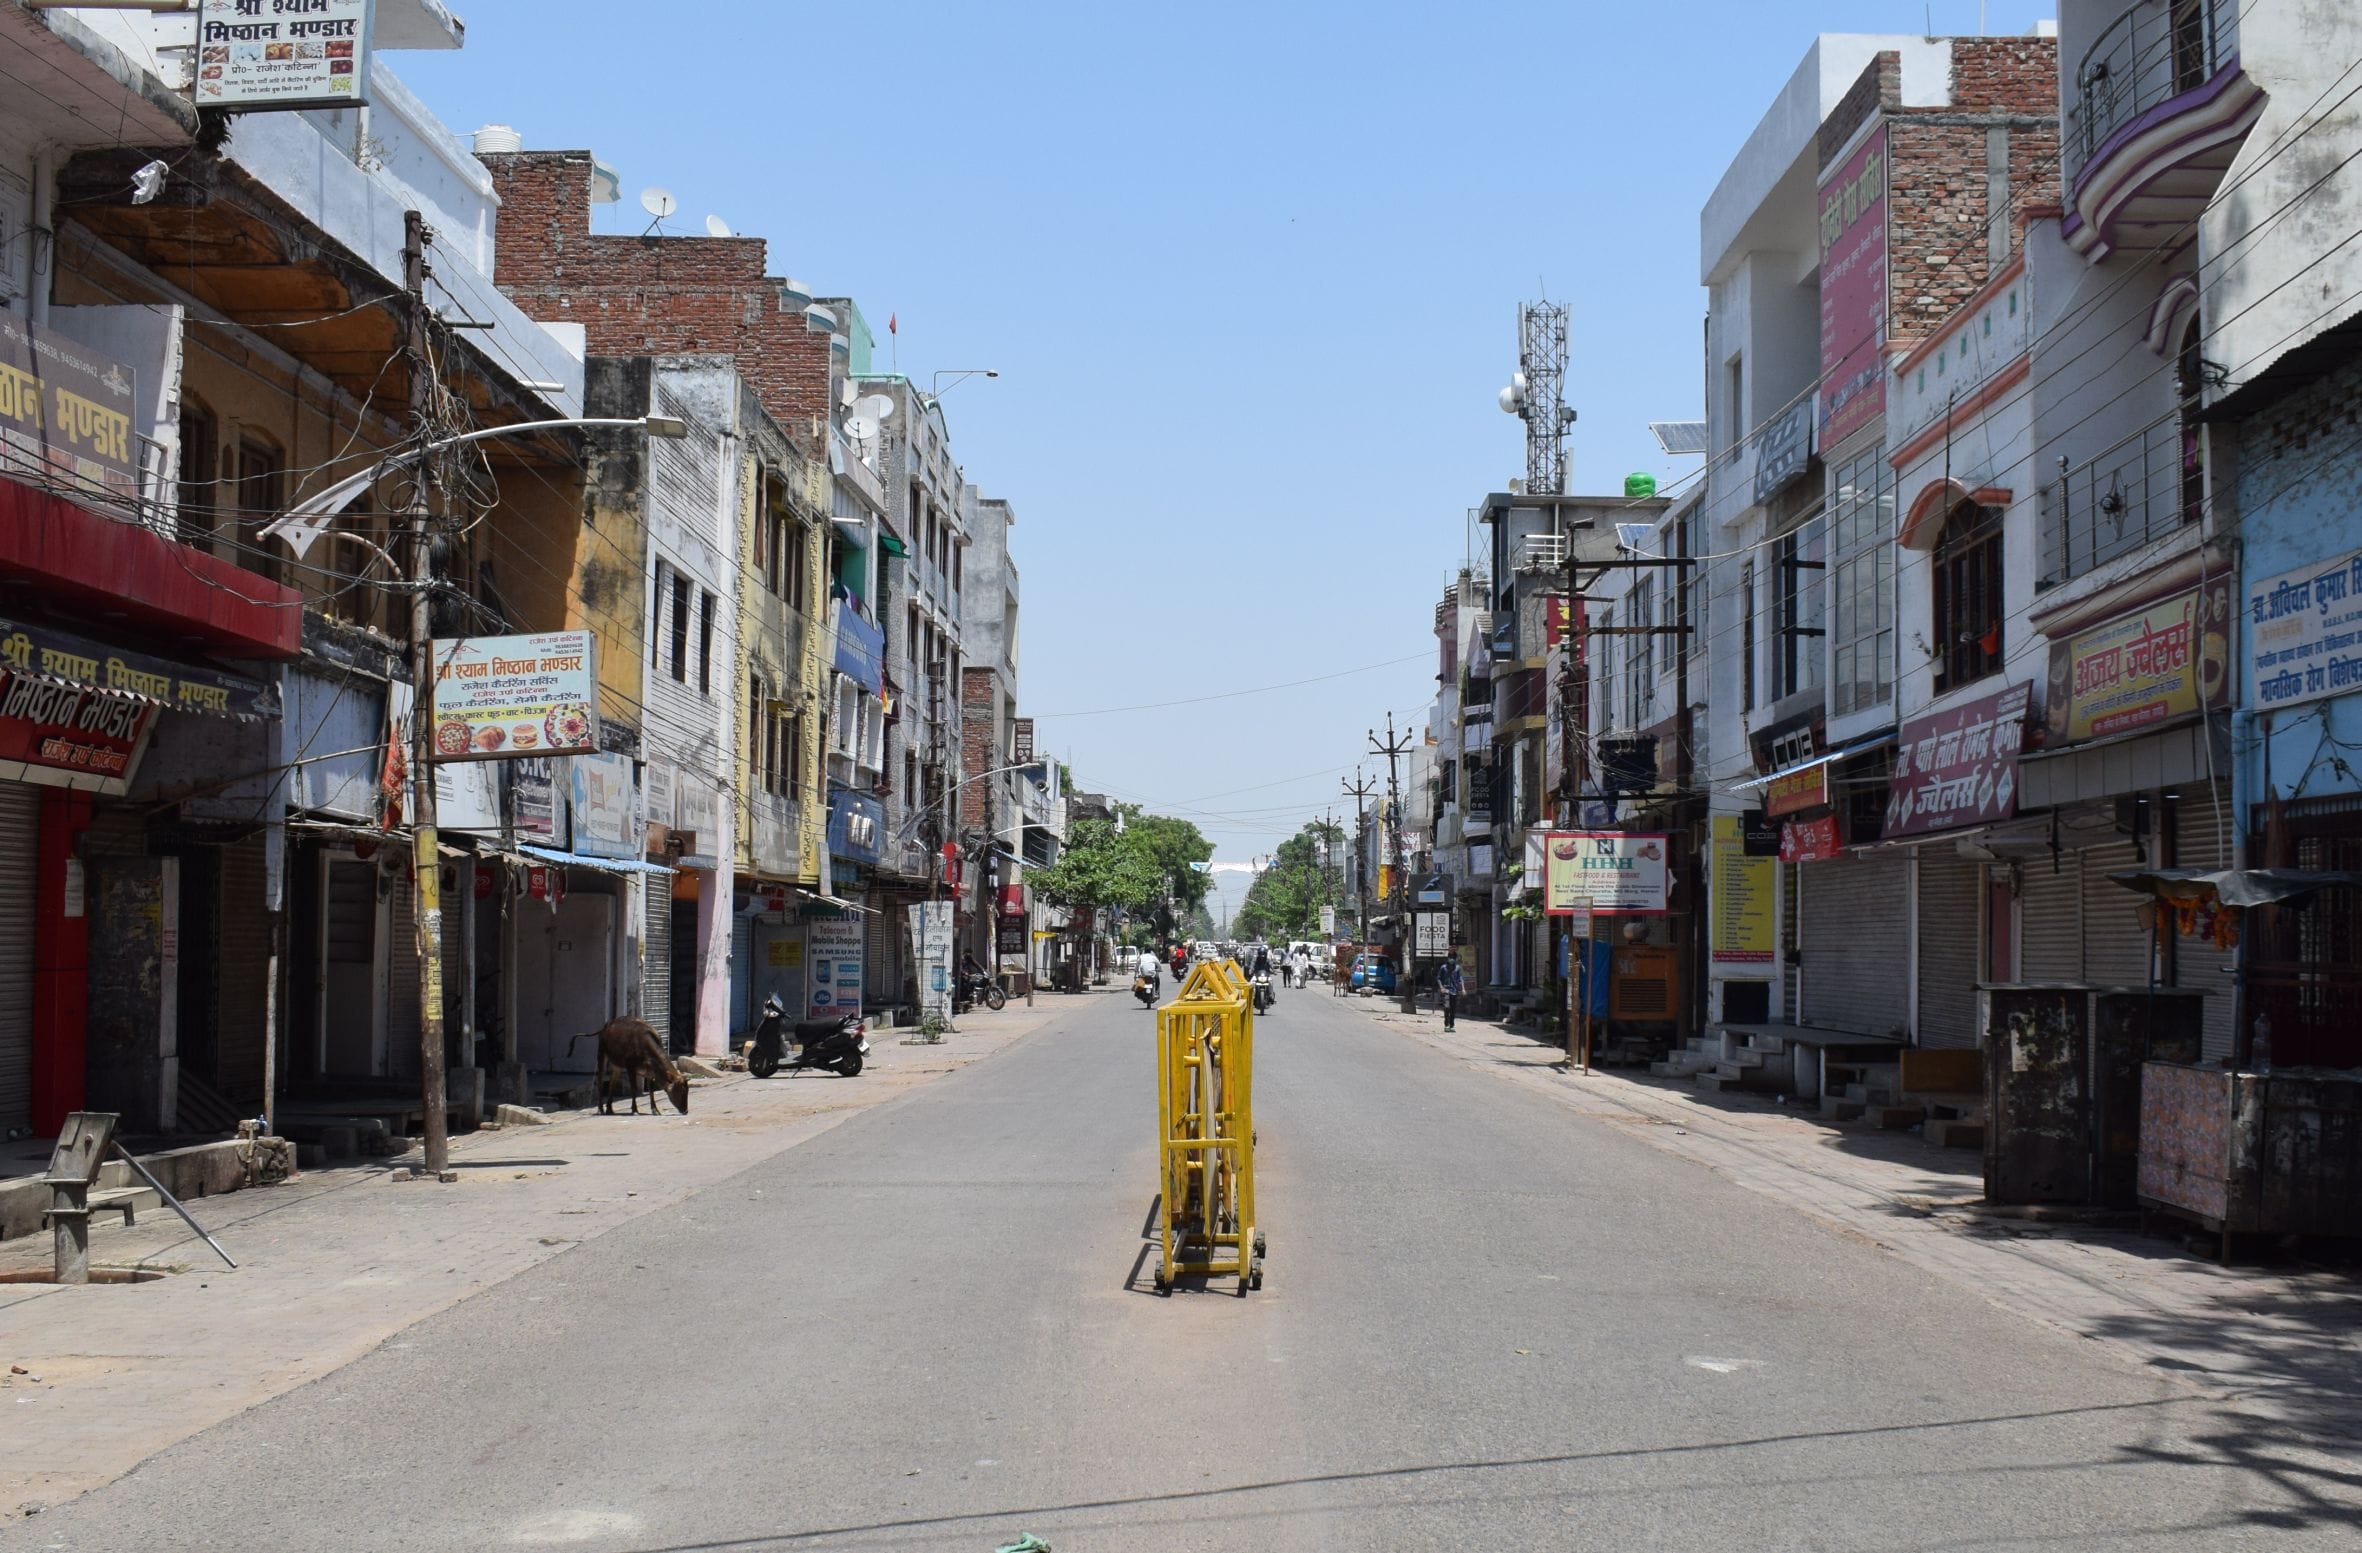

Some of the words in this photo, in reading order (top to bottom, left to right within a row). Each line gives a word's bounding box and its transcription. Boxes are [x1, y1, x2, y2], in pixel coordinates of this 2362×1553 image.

[204, 21, 280, 42] मिष्ठान
[290, 19, 357, 37] भण्डार
[56, 387, 129, 463] भण्डार
[2314, 569, 2347, 615] कुमार
[2, 633, 34, 669] श्री
[41, 647, 99, 683] श्याम
[178, 680, 229, 711] भण्डार
[456, 662, 488, 679] श्याम
[492, 656, 536, 677] मिष्ठान
[540, 655, 583, 672] भण्डार
[461, 681, 488, 692] राजेश
[2074, 645, 2122, 699] अजय
[2260, 669, 2302, 702] मानसिक
[2306, 663, 2325, 692] रोग
[1420, 926, 1446, 934] FOOD
